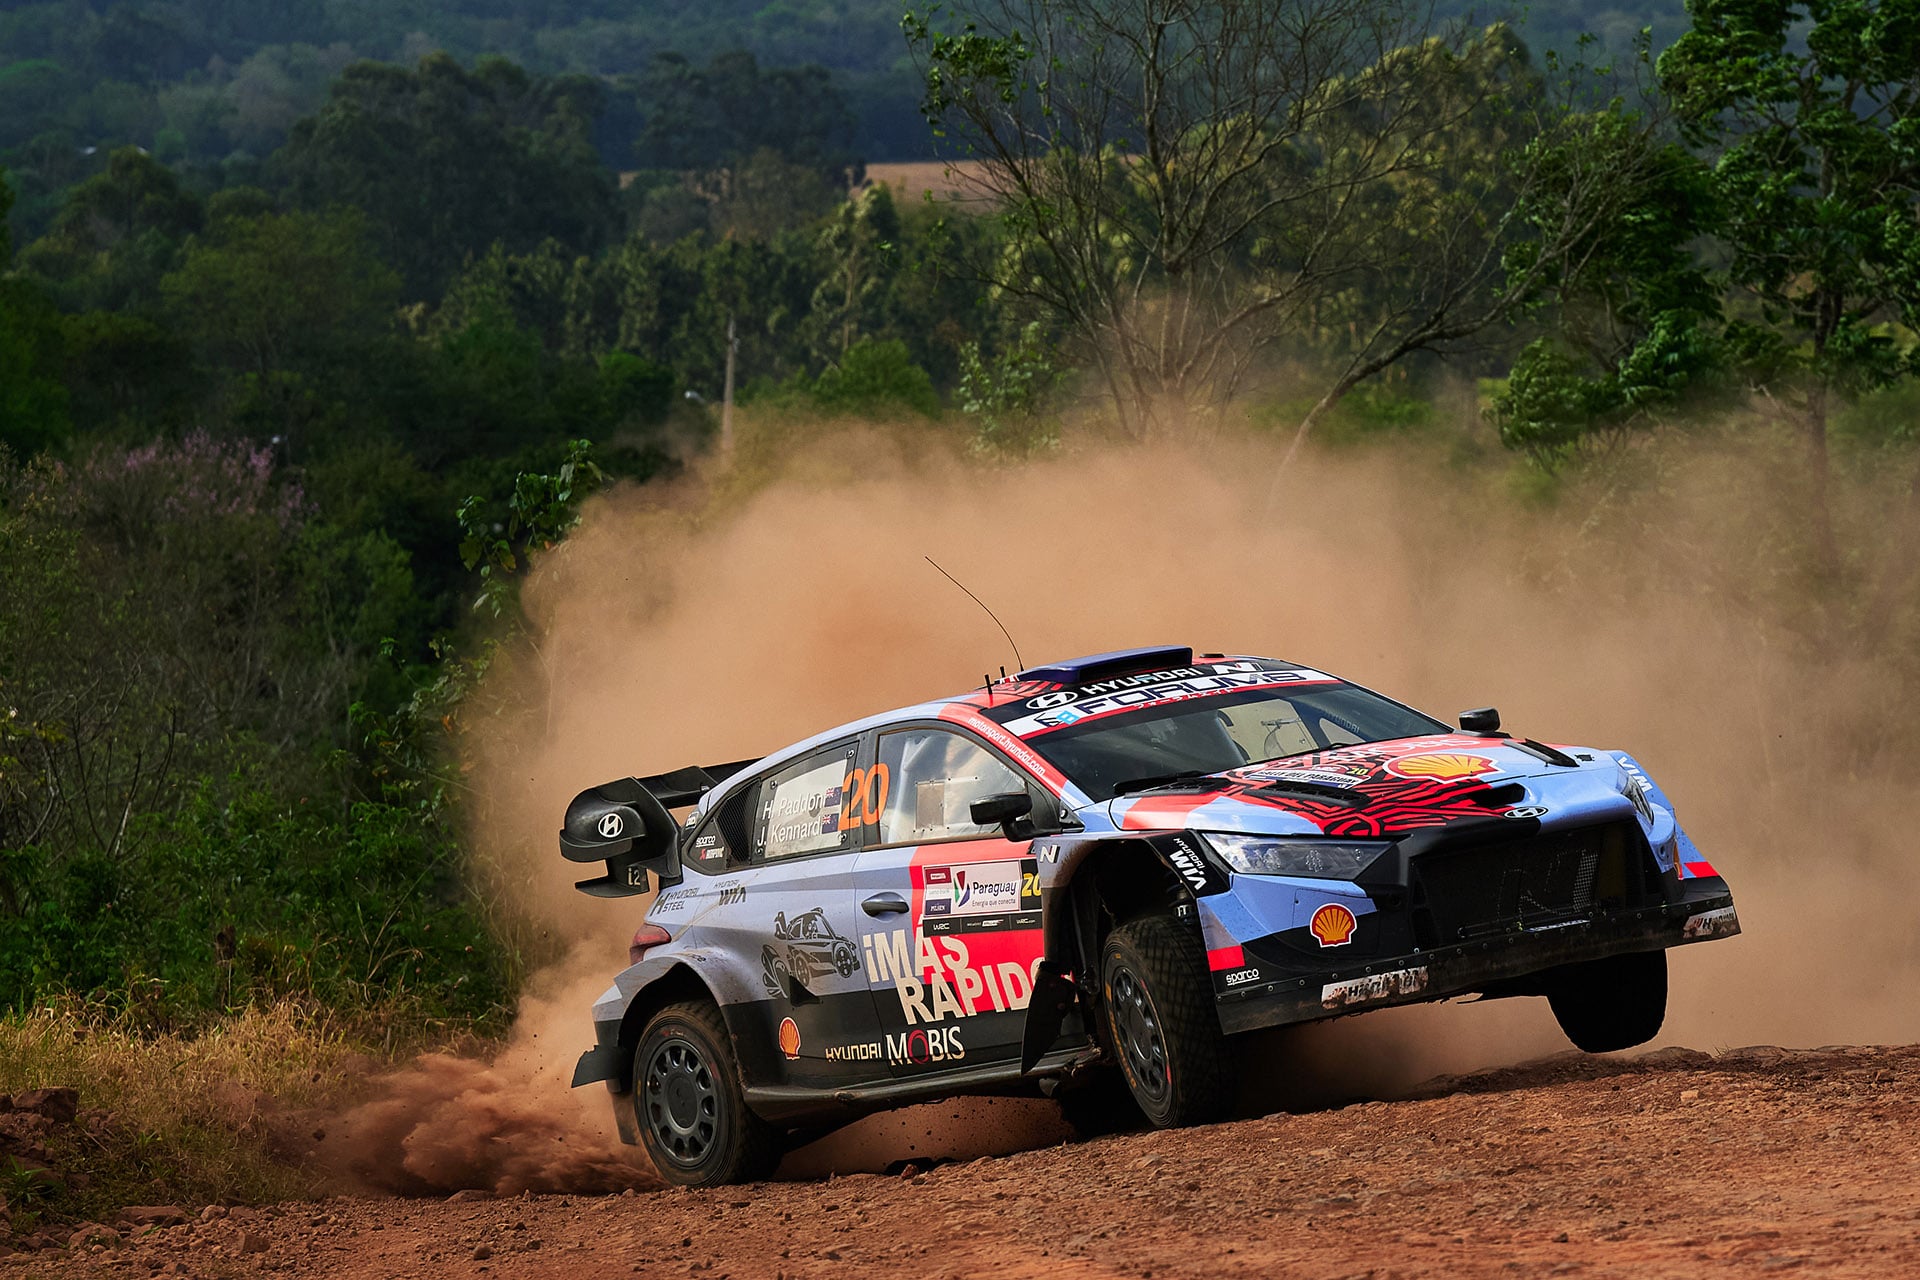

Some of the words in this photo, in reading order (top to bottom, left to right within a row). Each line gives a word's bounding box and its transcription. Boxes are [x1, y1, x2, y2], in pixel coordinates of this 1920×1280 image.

[1073, 672, 1307, 715] FORUM8
[1080, 667, 1204, 695] HYUNDAI
[968, 717, 1046, 776] motorsport.hyundai.com
[762, 800, 774, 820] H.
[778, 793, 825, 818] Paddon
[838, 763, 890, 831] 20
[757, 826, 767, 847] J.
[771, 816, 820, 845] Kennard
[1173, 837, 1205, 869] HYUNDAI
[972, 881, 1017, 897] Paraguay
[661, 901, 685, 913] STEEL
[933, 923, 950, 931] WRC
[1225, 968, 1260, 986] sparco
[825, 1042, 882, 1062] HYUNDAI
[885, 1025, 965, 1067] MOBIS
